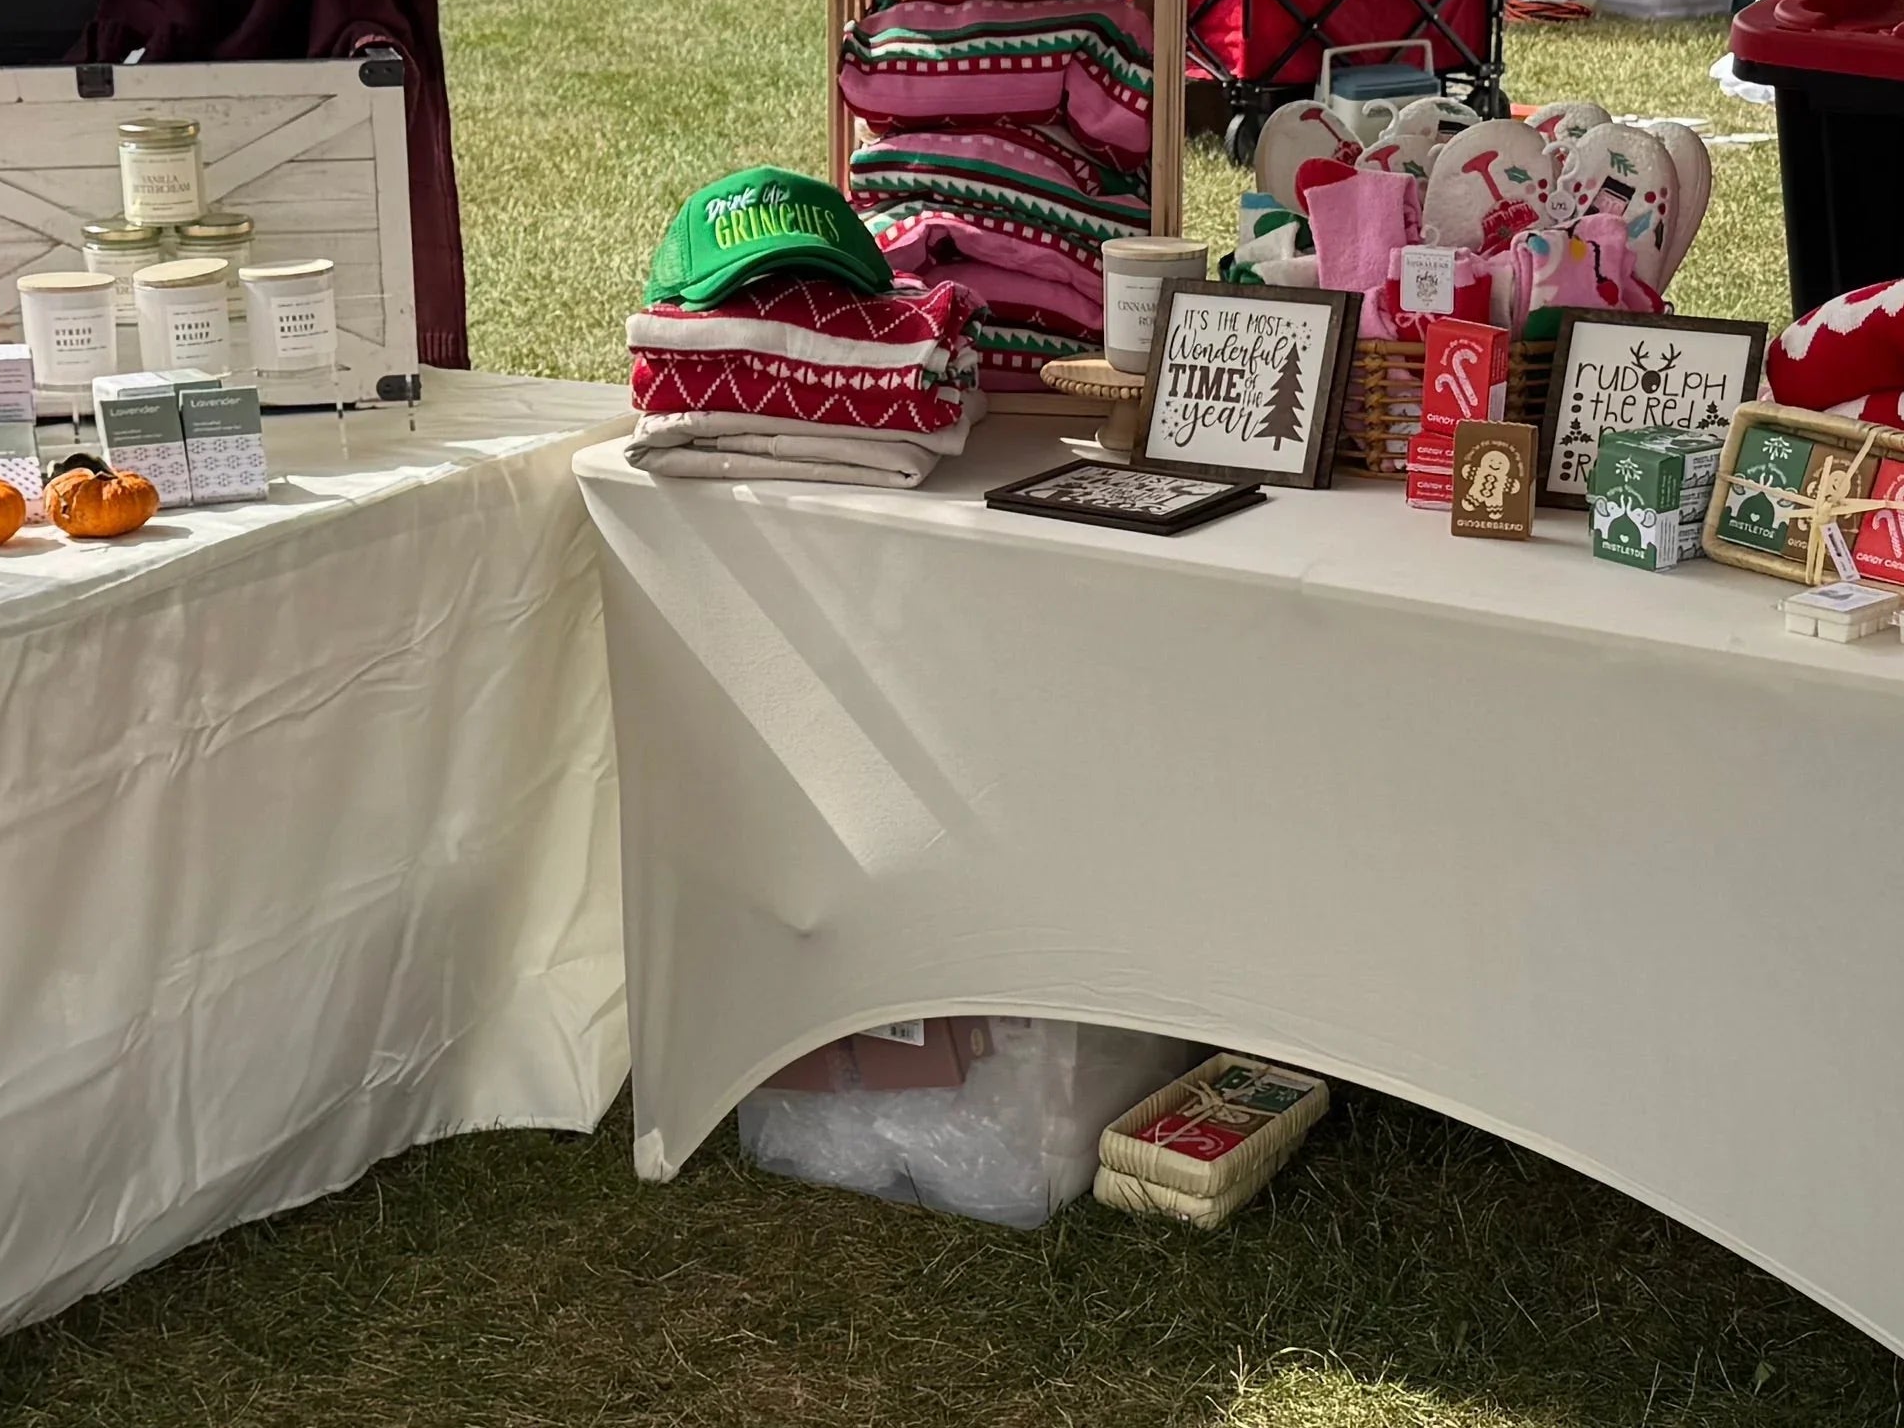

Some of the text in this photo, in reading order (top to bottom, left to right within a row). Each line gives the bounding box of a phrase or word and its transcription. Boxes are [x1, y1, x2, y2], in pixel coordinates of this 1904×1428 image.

[705, 186, 758, 224] Drink
[714, 202, 840, 251] GRINCHES
[279, 323, 315, 334] RELIEF
[1183, 309, 1283, 338] IT'S THE MOST
[55, 336, 93, 347] RELIEF
[174, 330, 211, 342] RELIEF
[1168, 324, 1290, 376] Wonderful
[1168, 363, 1258, 404] TIME of
[109, 403, 162, 418] Lavender
[189, 395, 242, 410] Lavender
[1174, 401, 1259, 448] year
[1728, 518, 1777, 540] MISTLETOE
[1602, 540, 1646, 560] MISTLETOE
[1855, 551, 1884, 567] CANDY
